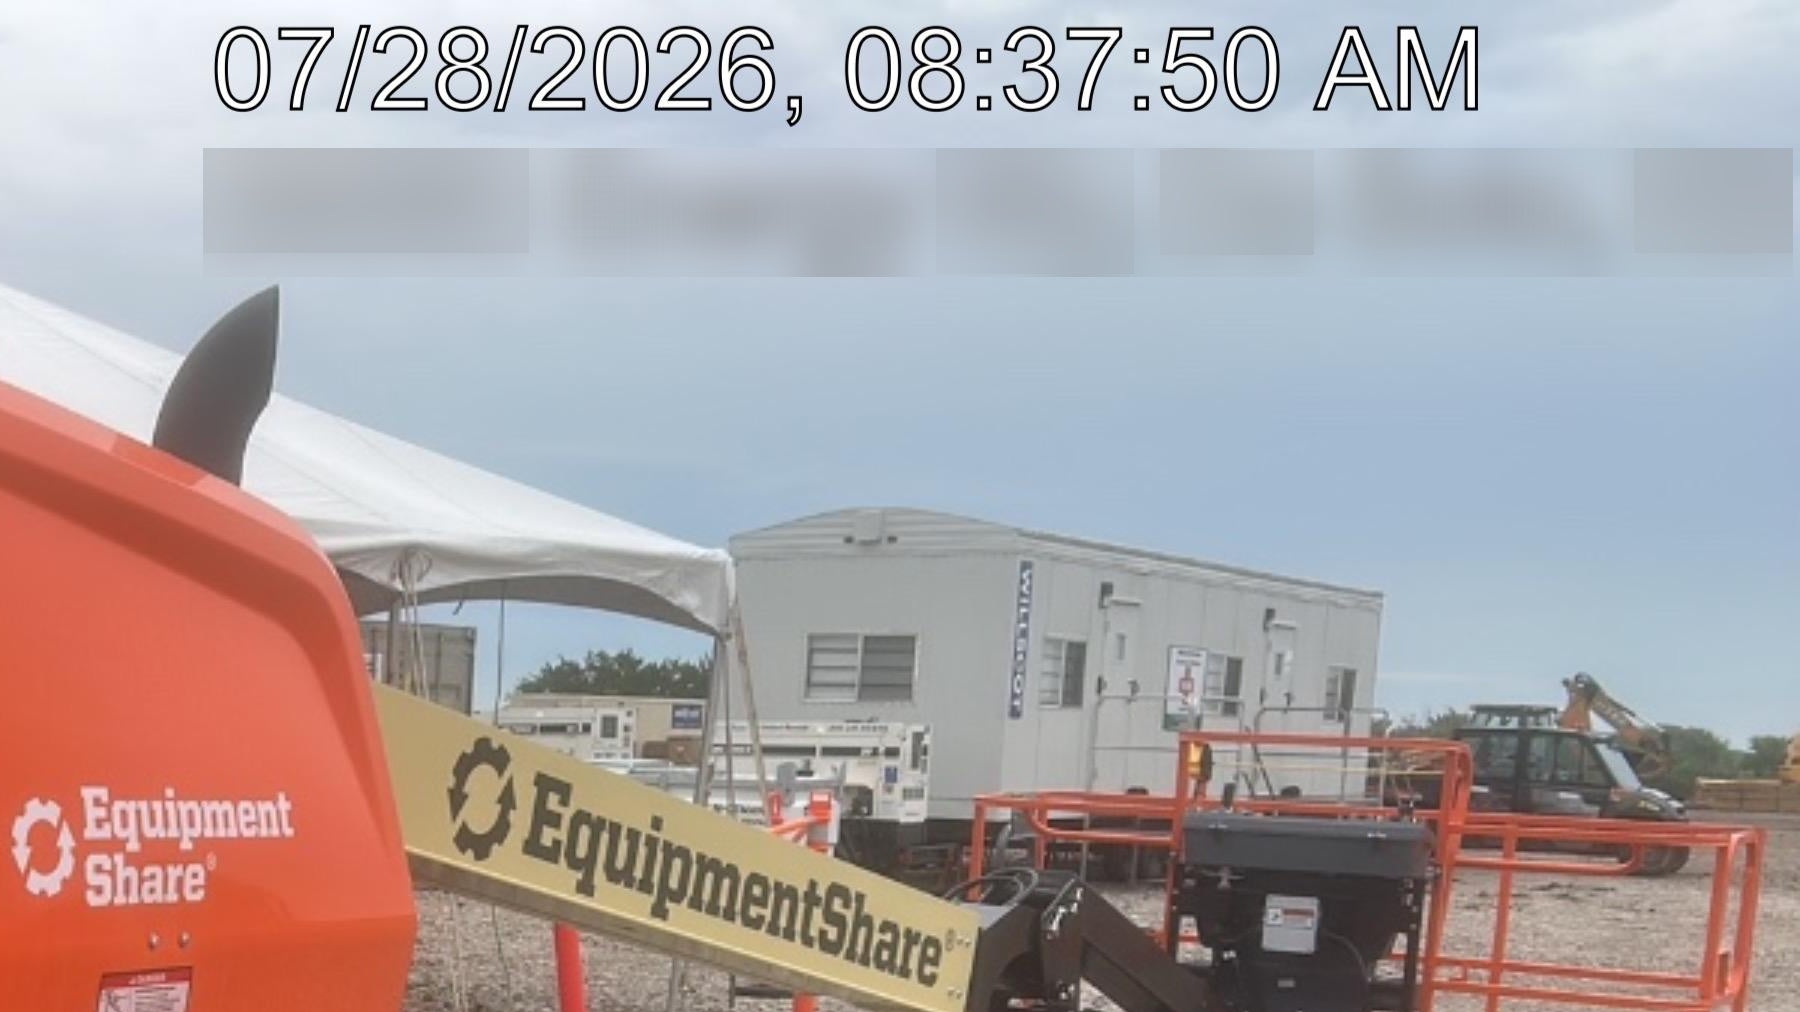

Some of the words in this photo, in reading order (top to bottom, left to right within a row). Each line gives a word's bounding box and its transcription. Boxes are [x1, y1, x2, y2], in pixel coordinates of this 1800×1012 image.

[1012, 568, 1033, 711] WILLOT
[80, 785, 294, 852] Equipment
[85, 853, 206, 907] Share
[522, 771, 943, 989] EquipmentShare
